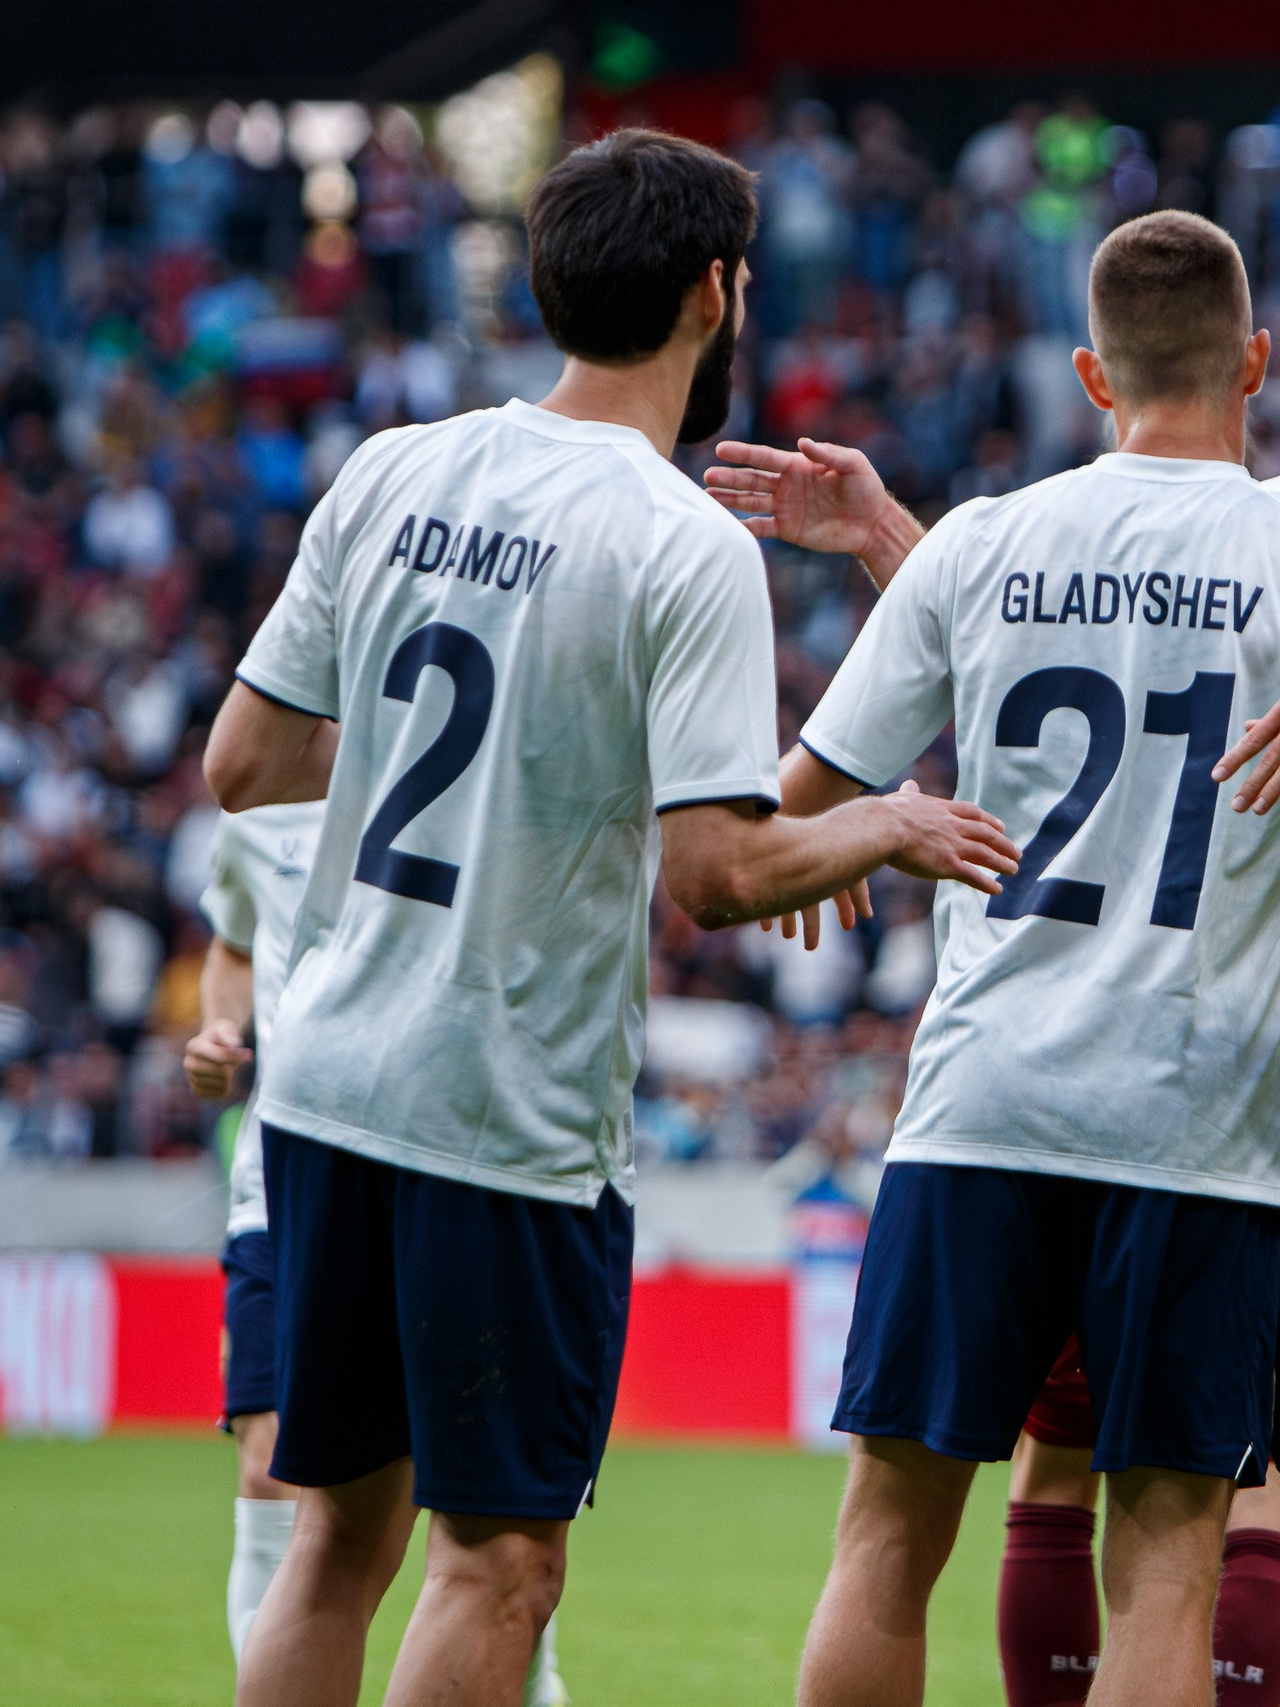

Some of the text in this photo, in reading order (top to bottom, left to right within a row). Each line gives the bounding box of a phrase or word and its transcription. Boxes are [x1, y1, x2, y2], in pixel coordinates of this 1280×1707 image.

[388, 514, 557, 595] ADAMOV
[1001, 570, 1264, 634] GLADYSHEV
[353, 621, 496, 909] 2
[985, 665, 1236, 931] 21
